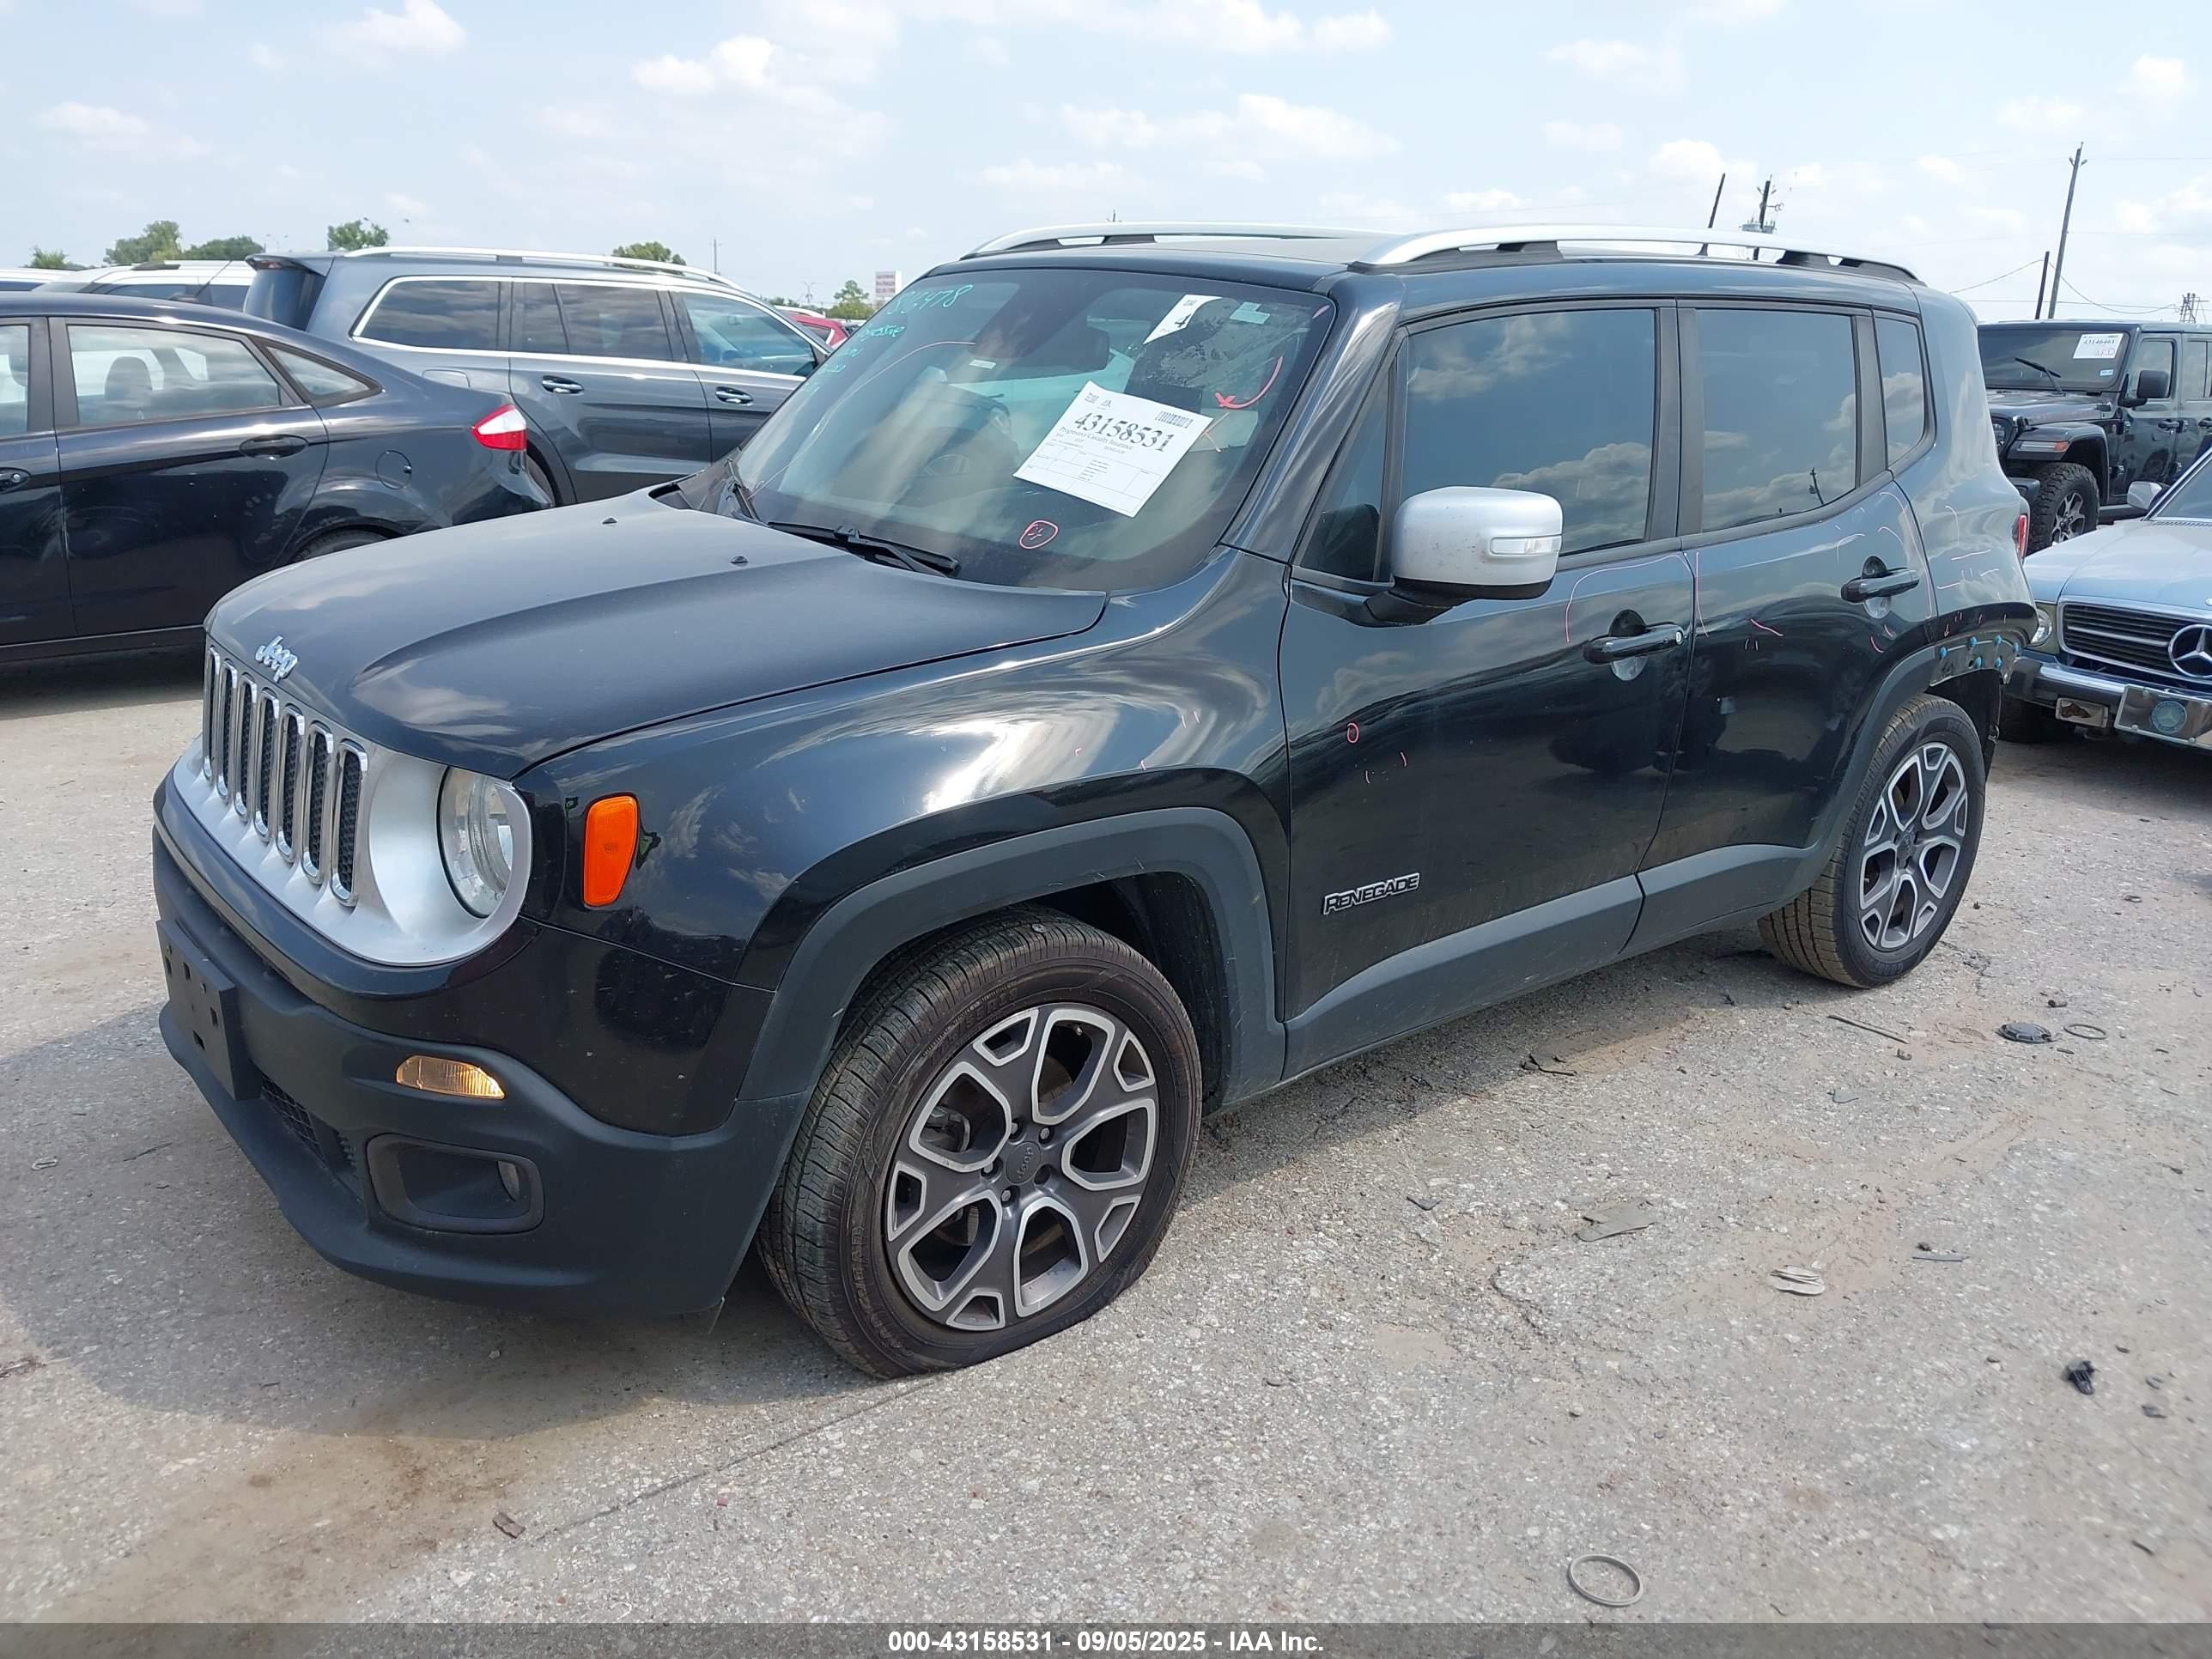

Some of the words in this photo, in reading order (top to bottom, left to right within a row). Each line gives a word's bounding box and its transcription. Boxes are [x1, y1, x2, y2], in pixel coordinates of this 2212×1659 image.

[1074, 412, 1175, 453] 43158531
[255, 635, 298, 683] Jeep
[1323, 872, 1420, 915] RENEGADE
